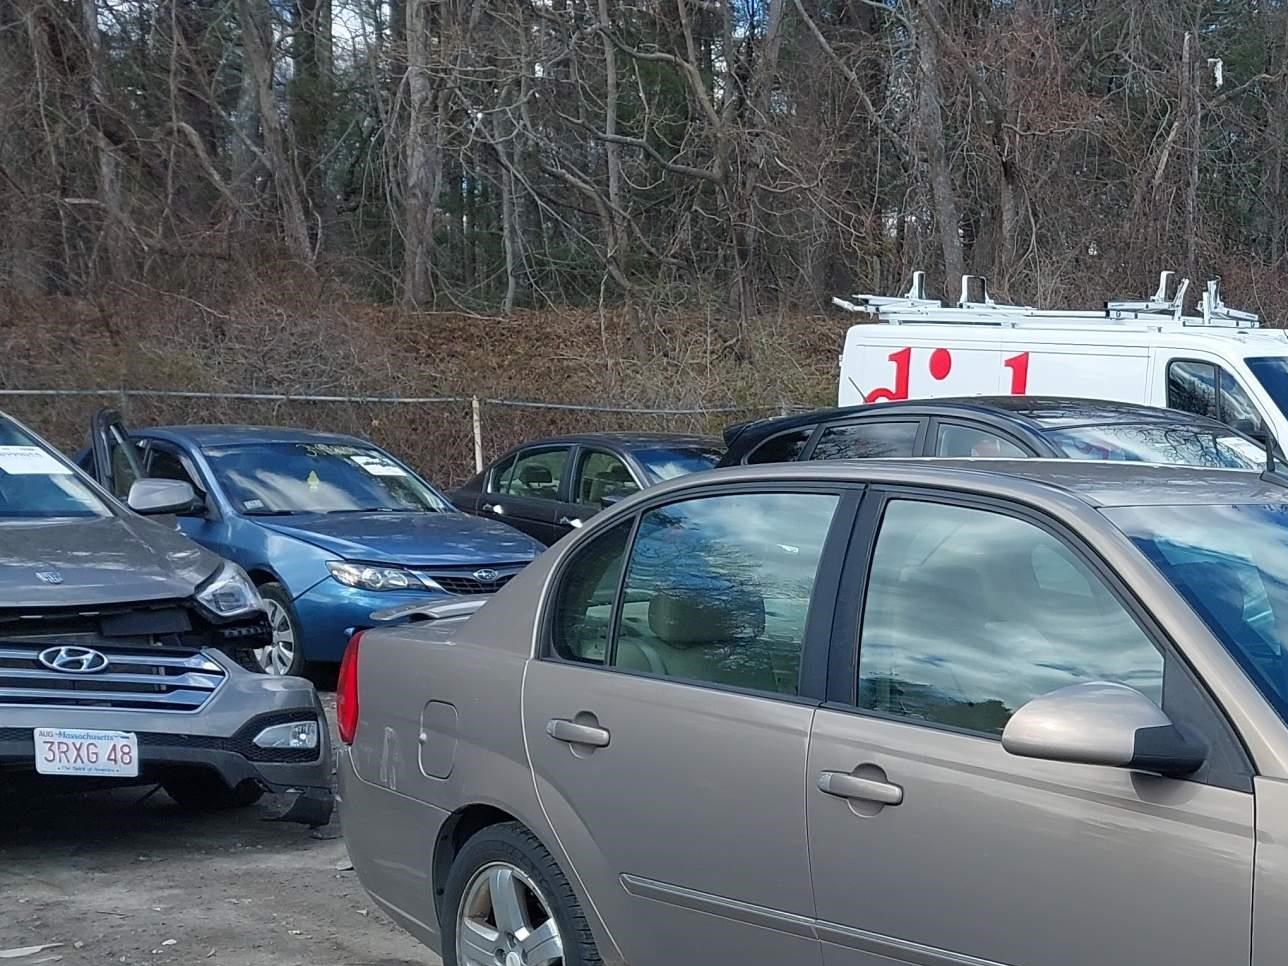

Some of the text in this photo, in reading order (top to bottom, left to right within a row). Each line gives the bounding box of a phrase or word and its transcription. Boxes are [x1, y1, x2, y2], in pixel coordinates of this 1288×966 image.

[39, 730, 54, 738] AUG
[43, 741, 133, 766] 3RXG 48
